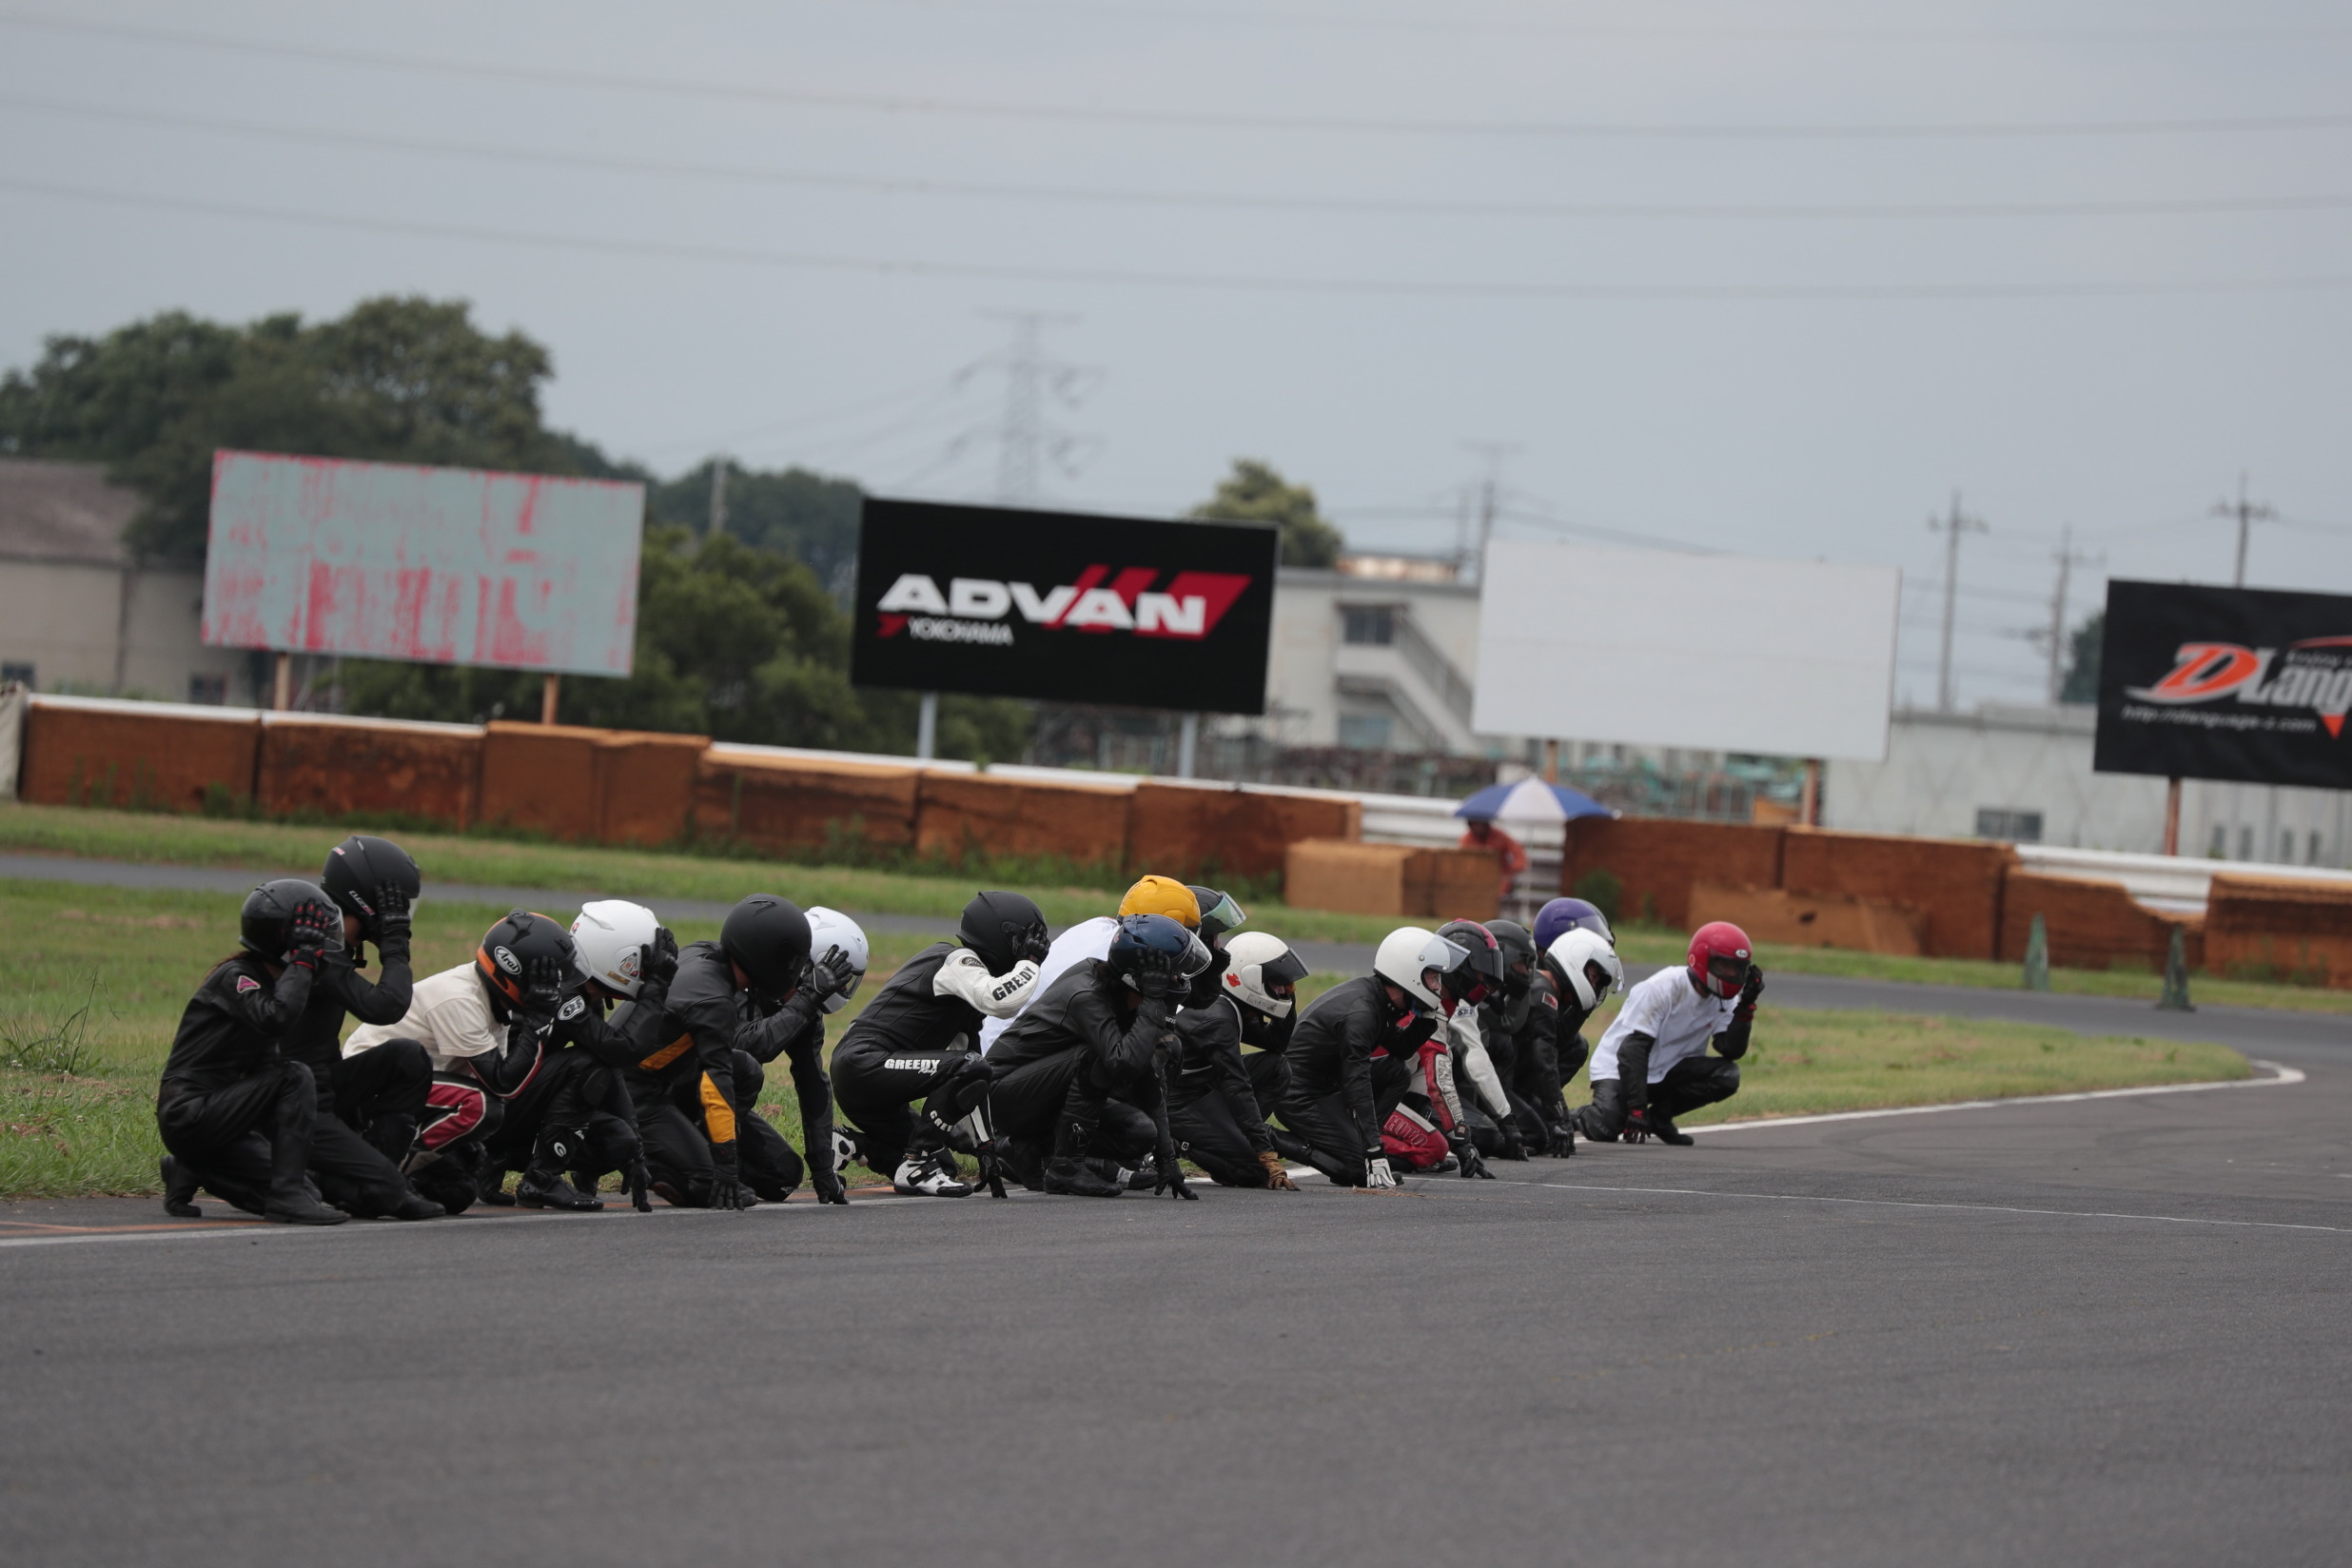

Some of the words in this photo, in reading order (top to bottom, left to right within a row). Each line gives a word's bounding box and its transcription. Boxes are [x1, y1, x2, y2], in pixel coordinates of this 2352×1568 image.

[876, 573, 1205, 635] ADVAN
[908, 617, 1014, 646] YOKOHAMA
[497, 951, 520, 972] Arai
[884, 1058, 941, 1070] GREEDY
